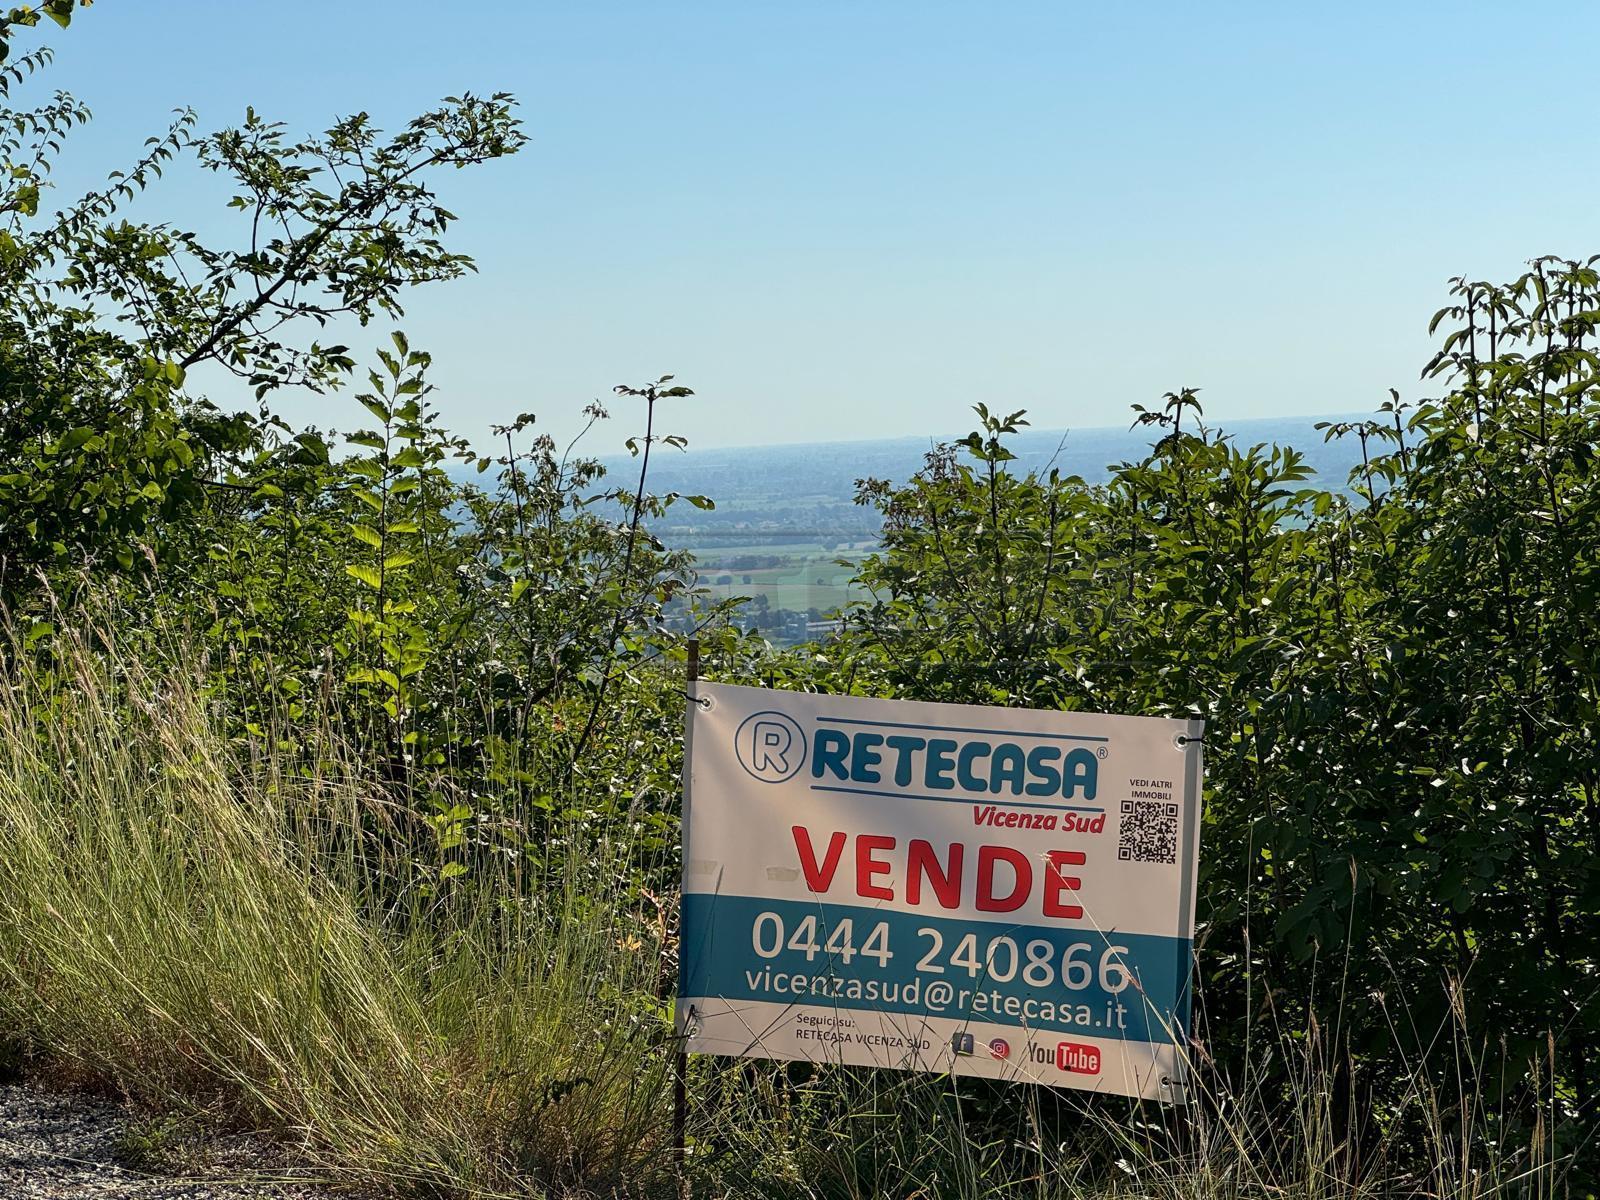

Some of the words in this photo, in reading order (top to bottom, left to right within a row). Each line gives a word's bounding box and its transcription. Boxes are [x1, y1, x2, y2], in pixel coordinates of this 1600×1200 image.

[1129, 779, 1149, 788] VEDI
[1150, 780, 1172, 789] ALTRI
[1131, 790, 1172, 800] IMMOBILI
[973, 806, 1058, 831] Vicenza
[1062, 812, 1107, 834] Sud
[791, 825, 1087, 920] VENDE
[752, 911, 894, 968] 0444
[915, 927, 1130, 994] 240866
[745, 965, 1128, 1030] vicenzasud@retecasa.it
[796, 1013, 836, 1027] Seguici
[838, 1017, 856, 1028] su:
[796, 1029, 852, 1043] RETECASA
[855, 1033, 904, 1048] VICENZA
[906, 1038, 931, 1051] SUD
[1028, 1041, 1098, 1072] YouTube
